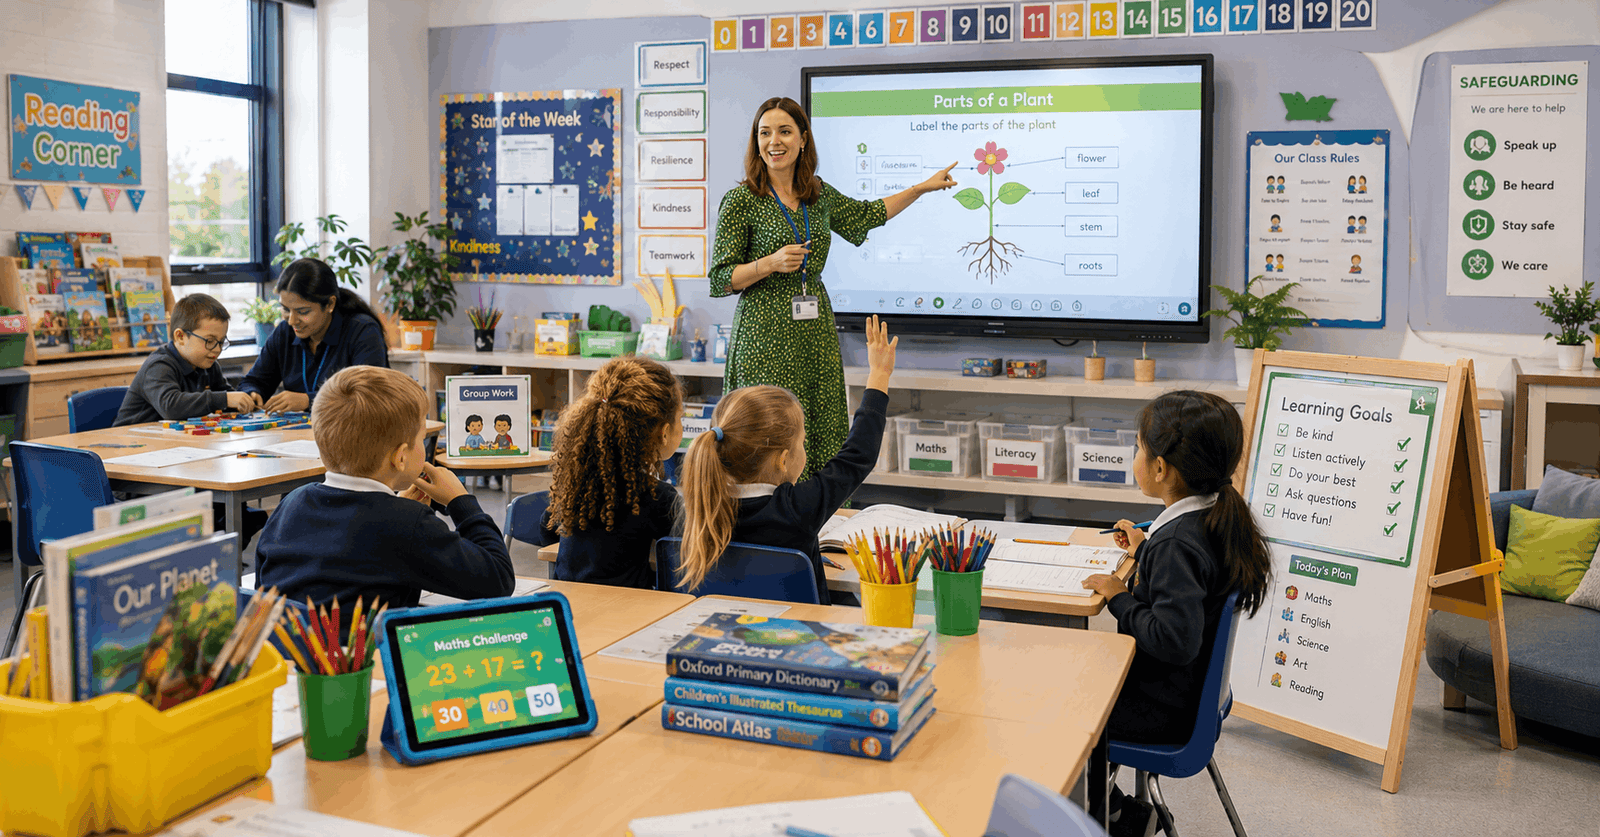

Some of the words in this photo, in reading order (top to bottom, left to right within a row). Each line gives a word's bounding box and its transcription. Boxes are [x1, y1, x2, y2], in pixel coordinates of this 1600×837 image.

[719, 27, 731, 45] 0
[749, 26, 757, 44] 1
[776, 24, 788, 42] 2
[805, 23, 817, 41] 3
[834, 21, 847, 40] 4
[865, 20, 877, 39] 6
[895, 19, 908, 37] 7
[926, 17, 940, 37] 8
[959, 16, 971, 35] 9
[986, 14, 1008, 34] 10
[1027, 13, 1045, 33] 11
[1059, 12, 1080, 31] 12
[1092, 10, 1114, 30] 13
[1126, 9, 1148, 29] 14
[1161, 8, 1182, 27] 15
[1196, 6, 1218, 27] 16
[1232, 5, 1255, 25] 17
[1268, 3, 1291, 24] 18
[1305, 2, 1328, 23] 19
[1341, 0, 1370, 22] 20
[653, 59, 690, 72] Respect
[1459, 73, 1579, 89] SAFEGUARDING
[933, 94, 973, 109] Parts
[978, 92, 995, 108] of
[998, 96, 1009, 107] a
[1013, 92, 1054, 107] Plant
[644, 107, 700, 120] Responsibility
[1471, 105, 1487, 114] We
[1489, 106, 1504, 114] are
[1507, 105, 1529, 113] here
[1532, 105, 1542, 113] to
[1545, 103, 1566, 114] help
[25, 94, 130, 139] Reading
[471, 113, 498, 129] Star
[502, 112, 516, 128] of
[518, 112, 541, 127] the
[544, 110, 582, 126] Week
[910, 120, 937, 132] Label
[940, 120, 958, 131] the
[961, 120, 989, 133] parts
[992, 119, 1005, 130] of
[1008, 119, 1025, 130] the
[1028, 119, 1056, 132] plant
[34, 133, 121, 168] Corner
[1504, 140, 1539, 152] Speak
[1542, 142, 1557, 152] up
[650, 155, 693, 165] Resilience
[1077, 153, 1106, 163] flower
[1274, 153, 1295, 163] Our
[1298, 153, 1327, 163] Class
[1330, 153, 1360, 163] Rules
[1503, 181, 1517, 190] Be
[1521, 180, 1555, 190] heard
[1082, 188, 1101, 198] leaf
[652, 203, 692, 213] Kindness
[1080, 223, 1102, 231] stem
[1502, 221, 1527, 232] Stay
[1531, 220, 1555, 230] safe
[649, 250, 695, 261] Teamwork
[1078, 261, 1103, 271] roots
[1501, 261, 1520, 271] We
[1523, 262, 1548, 271] care
[463, 389, 490, 400] Group
[492, 388, 515, 398] Work
[1281, 397, 1344, 422] Learning
[1349, 405, 1393, 423] Goals
[1296, 427, 1309, 438] Be
[1312, 429, 1333, 442] kind
[915, 443, 947, 454] Maths
[995, 447, 1037, 461] Literacy
[1082, 452, 1124, 464] Science
[1292, 447, 1322, 461] Listen
[1325, 453, 1366, 470] actively
[1289, 467, 1303, 479] Do
[1306, 471, 1330, 484] your
[1333, 474, 1356, 488] best
[1285, 488, 1304, 501] Ask
[1307, 493, 1357, 509] questions
[1281, 508, 1307, 522] Have
[1311, 513, 1332, 526] fun!
[1295, 560, 1329, 576] Today's
[1331, 567, 1352, 580] Plan
[113, 583, 155, 614] Our
[160, 559, 219, 598] Planet
[1304, 592, 1332, 607] Maths
[1300, 614, 1331, 630] English
[434, 639, 471, 652] Maths
[472, 632, 528, 645] Challenge
[1297, 636, 1330, 652] Science
[426, 663, 457, 687] 23
[463, 664, 476, 678] +
[481, 656, 504, 678] 17
[511, 659, 525, 670] =
[530, 651, 543, 671] ?
[1292, 658, 1308, 670] Art
[679, 659, 723, 676] Oxford
[726, 665, 774, 684] Primary
[775, 670, 840, 692] Dictionary
[1289, 680, 1324, 701] Reading
[438, 706, 462, 724] 30
[487, 698, 509, 715] 40
[533, 692, 555, 708] 50
[674, 687, 728, 704] Children's
[729, 694, 784, 712] Illustrated
[787, 701, 843, 718] Thesaurus
[676, 712, 728, 733] School
[731, 721, 772, 739] Atlas
